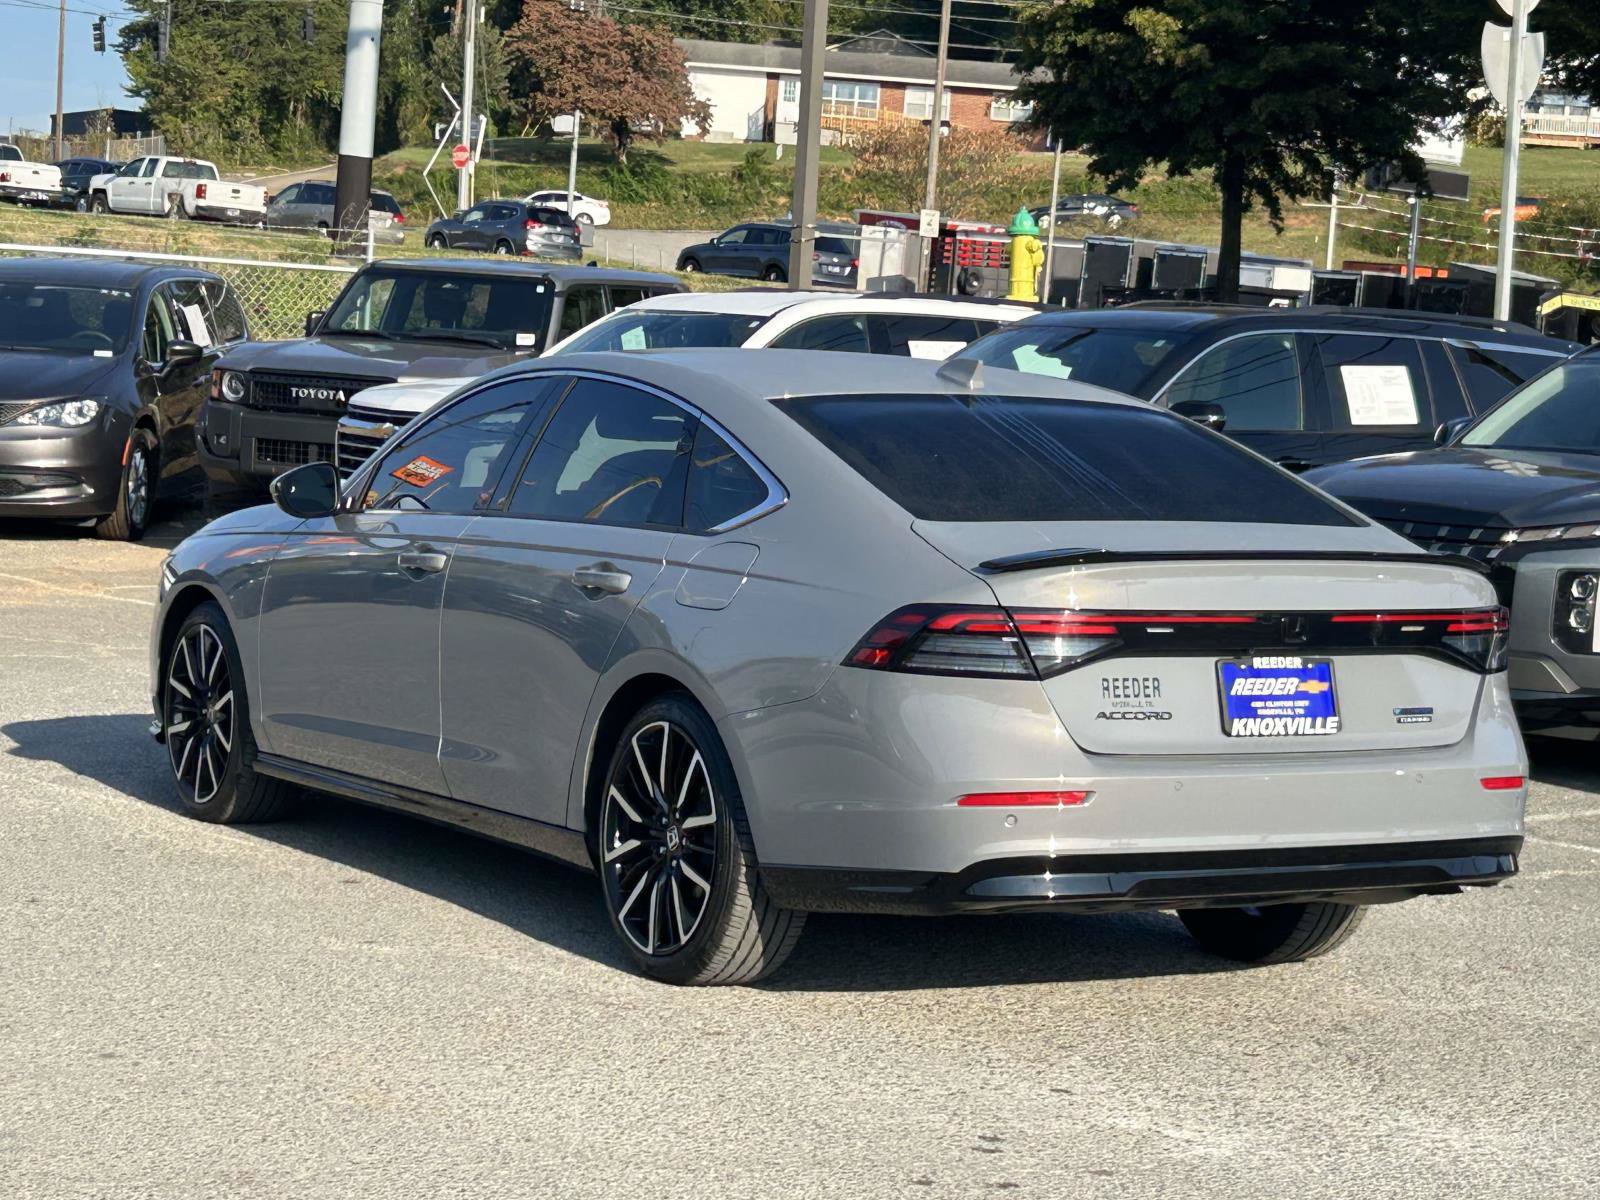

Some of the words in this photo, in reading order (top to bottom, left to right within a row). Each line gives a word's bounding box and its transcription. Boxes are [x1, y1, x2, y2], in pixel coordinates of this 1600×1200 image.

[290, 387, 346, 402] TOYOTA
[1253, 656, 1303, 669] REEDER
[1101, 677, 1162, 699] REEDER
[1230, 677, 1300, 695] REEDER
[1095, 711, 1173, 720] ACCORD
[1231, 716, 1339, 736] KNOXVILLE
